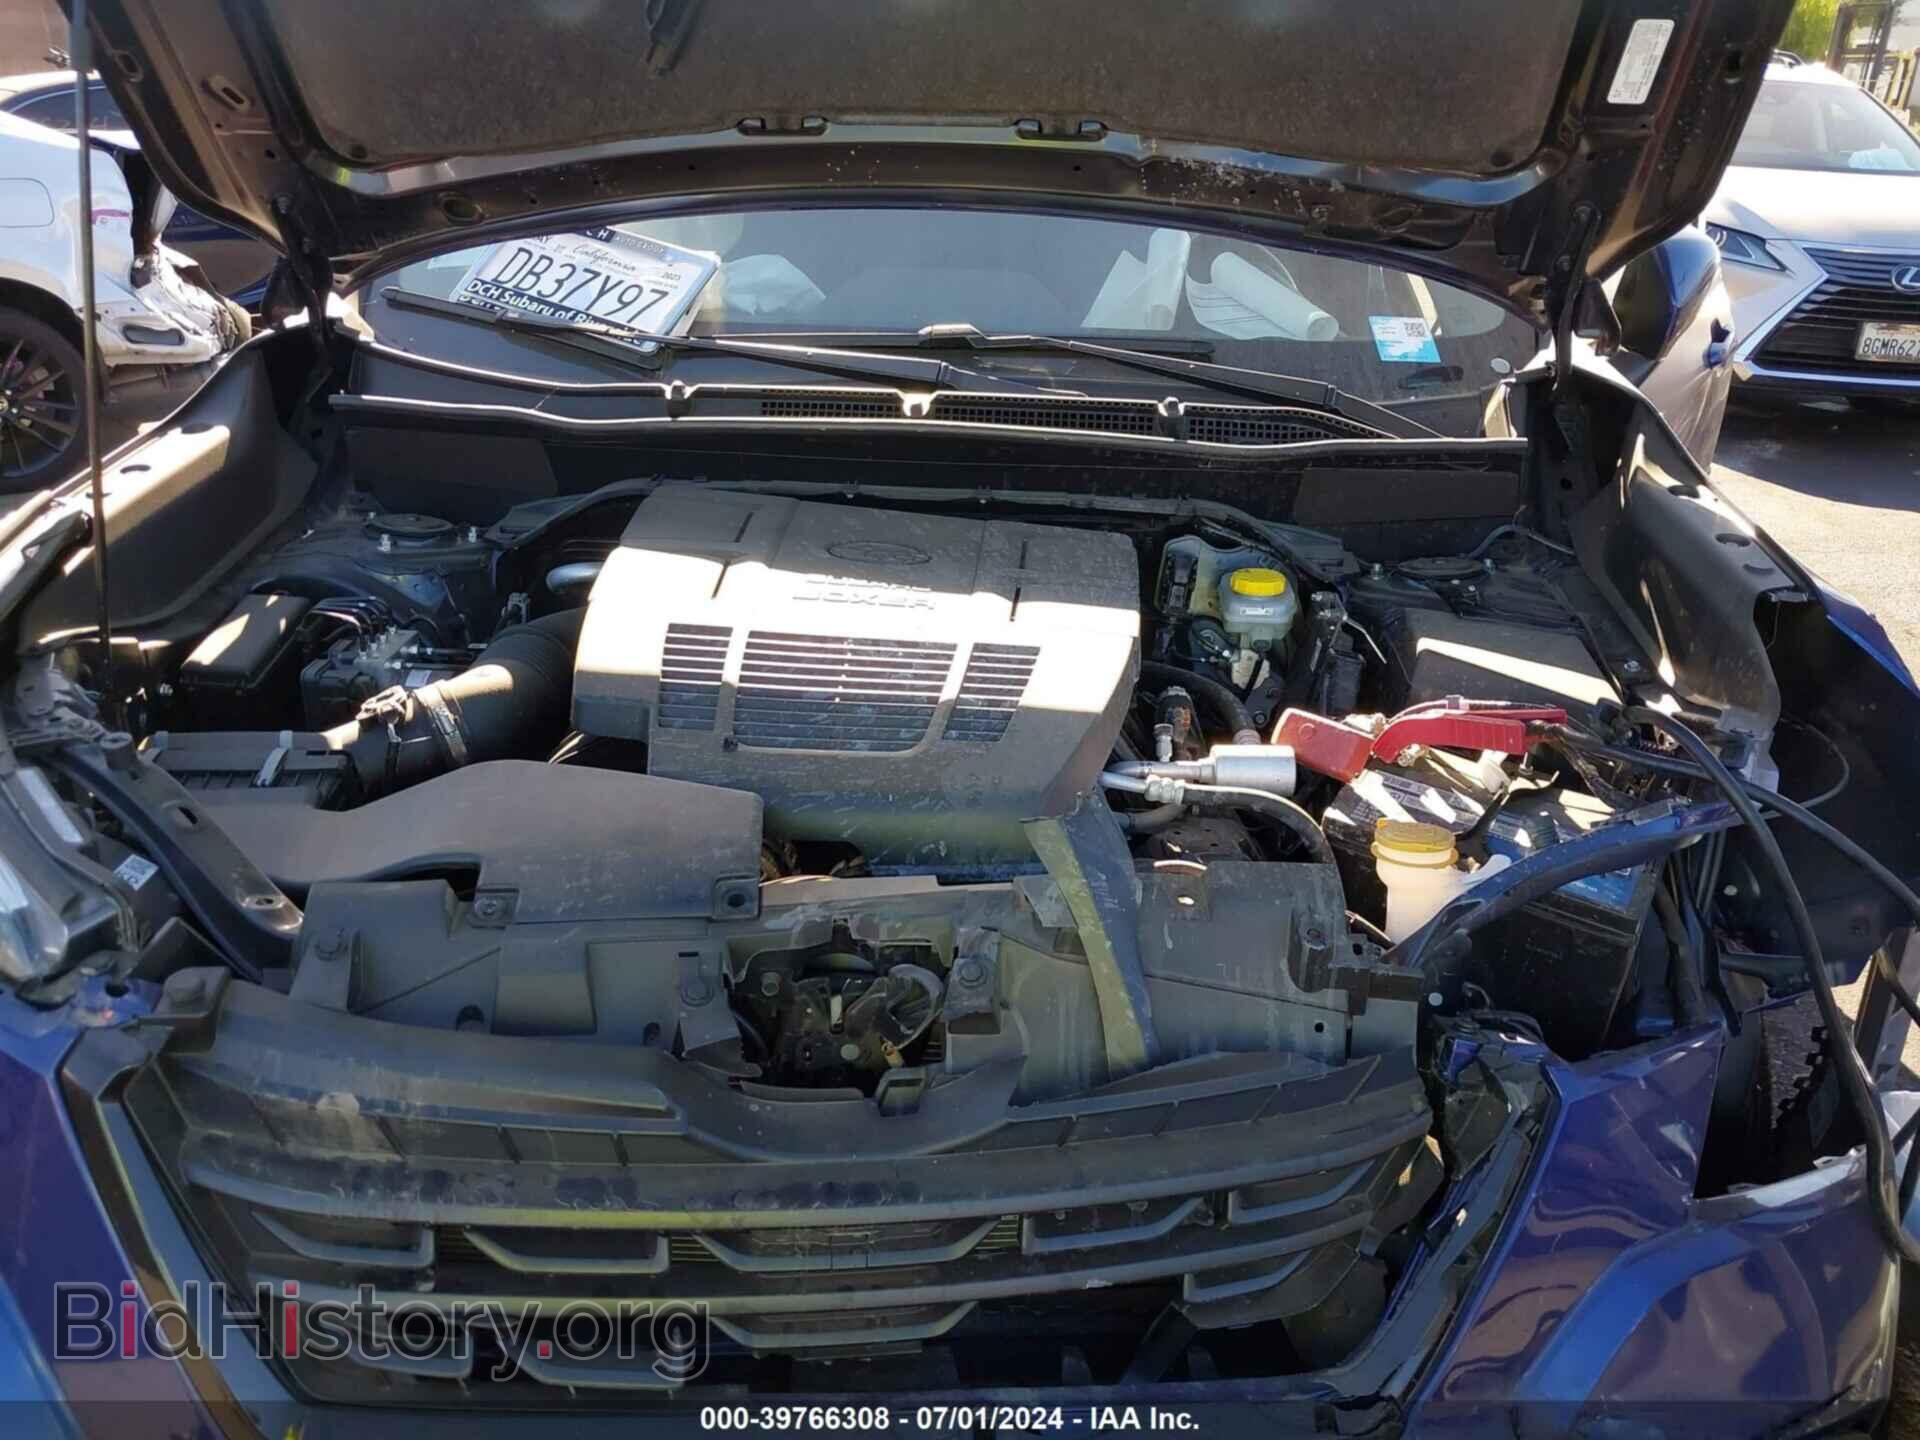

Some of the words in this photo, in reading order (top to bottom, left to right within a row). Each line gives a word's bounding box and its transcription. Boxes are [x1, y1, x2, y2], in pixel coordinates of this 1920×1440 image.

[572, 244, 637, 272] California
[467, 280, 502, 299] DCH
[500, 290, 555, 316] Subaru
[552, 308, 577, 321] of
[492, 247, 669, 324] DB37Y97
